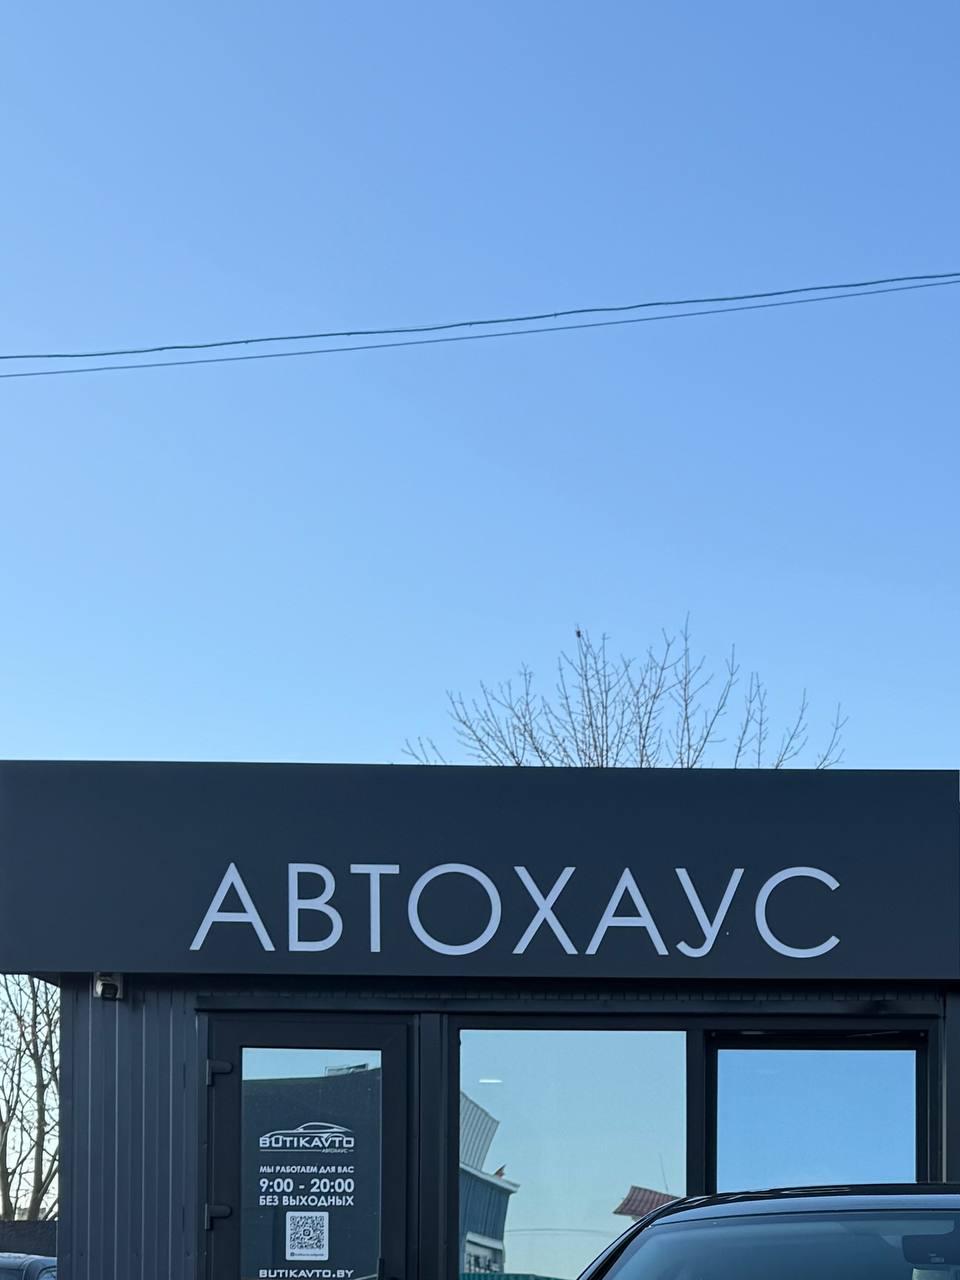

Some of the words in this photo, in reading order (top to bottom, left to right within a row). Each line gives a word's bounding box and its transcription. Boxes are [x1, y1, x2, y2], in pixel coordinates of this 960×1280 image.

[189, 862, 841, 959] АВТОХАУС
[259, 1136, 355, 1148] BUTIKAVTO
[319, 1166, 336, 1174] ДЛЯ
[260, 1178, 294, 1192] 9:00
[310, 1178, 355, 1192] 20:00
[259, 1195, 279, 1206] БЕЗ
[282, 1195, 354, 1207] ВЫХОДНЫХ
[259, 1269, 354, 1278] BUTIKAVTO.BY
